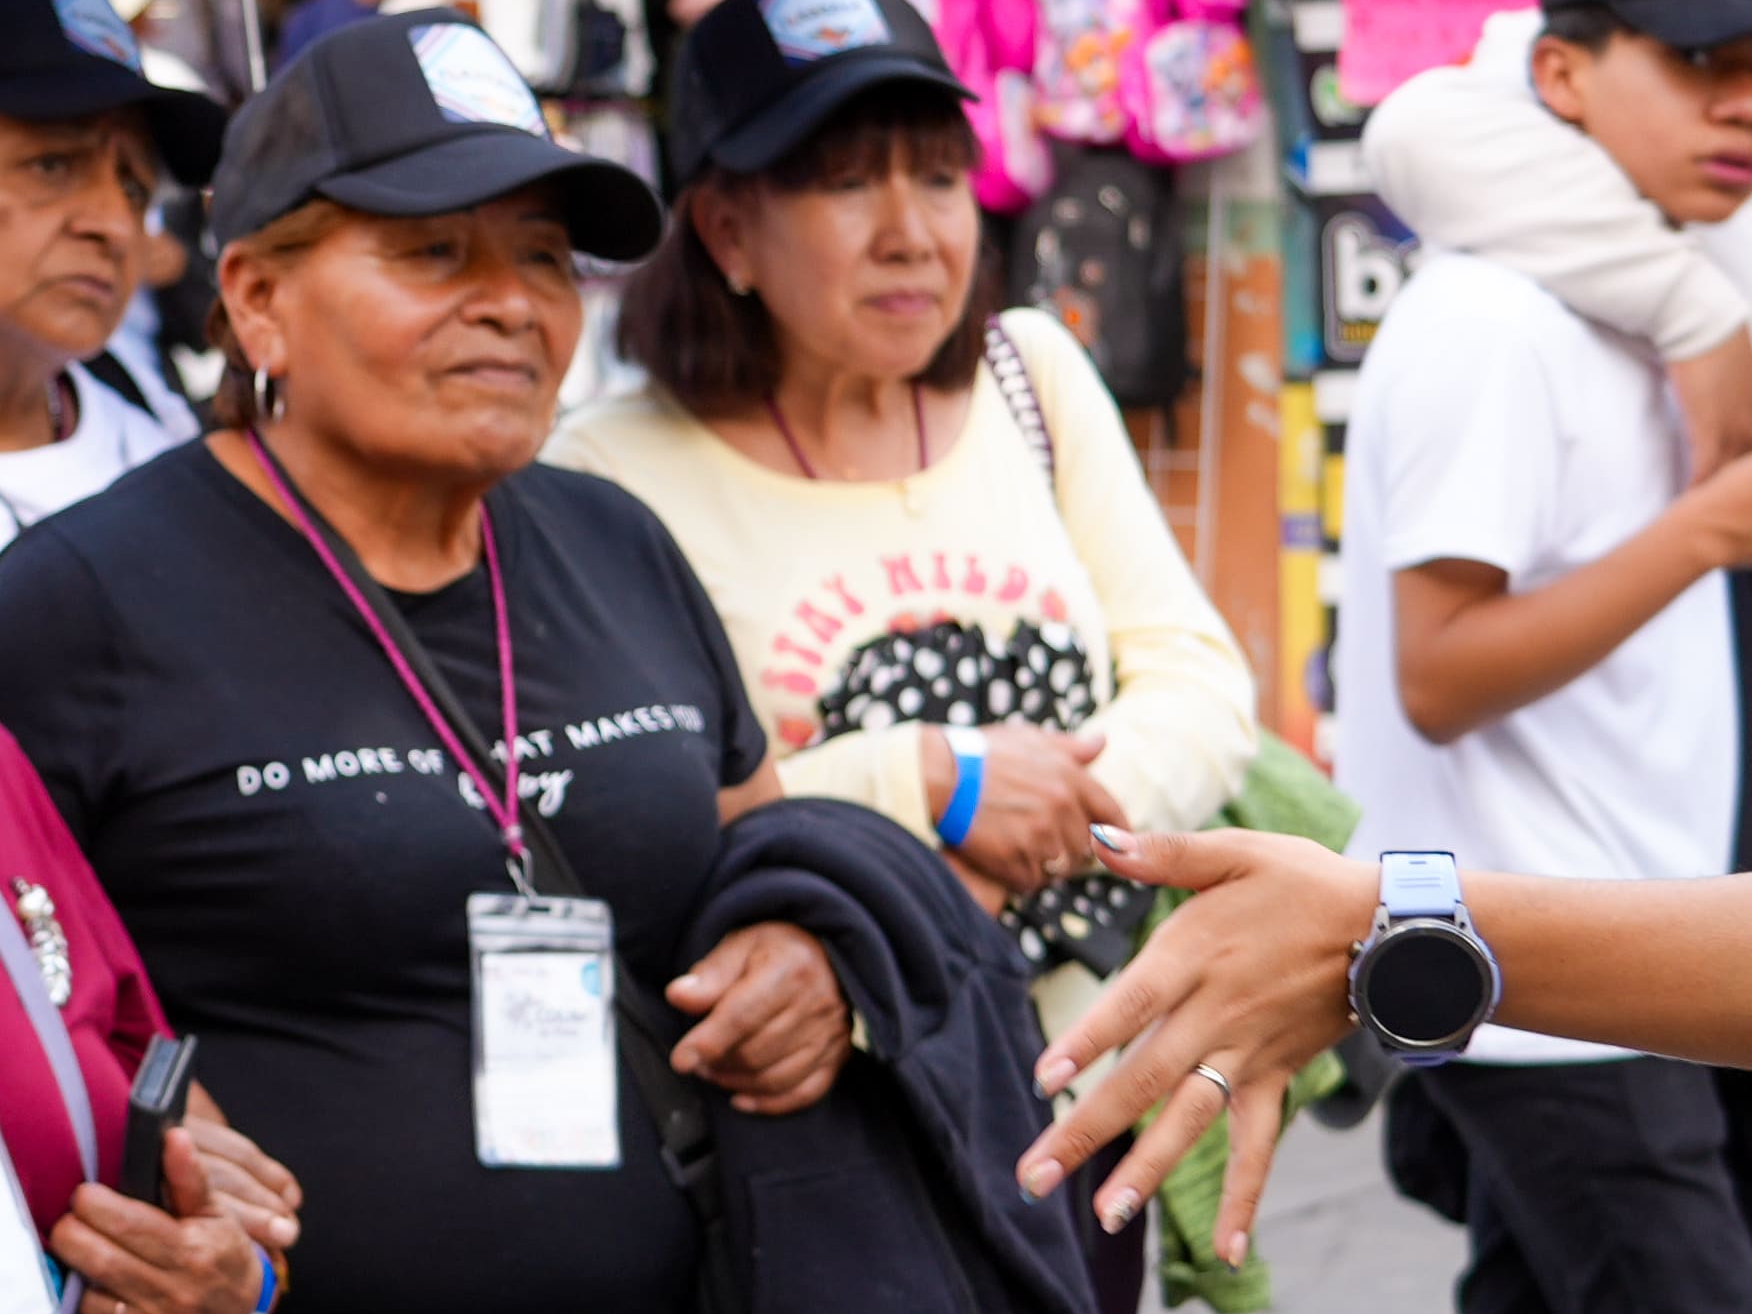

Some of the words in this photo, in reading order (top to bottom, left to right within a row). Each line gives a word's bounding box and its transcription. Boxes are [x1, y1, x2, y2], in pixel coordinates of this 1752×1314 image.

[237, 762, 291, 796] DO
[302, 747, 403, 783] MORE
[408, 749, 445, 775] OF
[565, 705, 673, 749] MAKES
